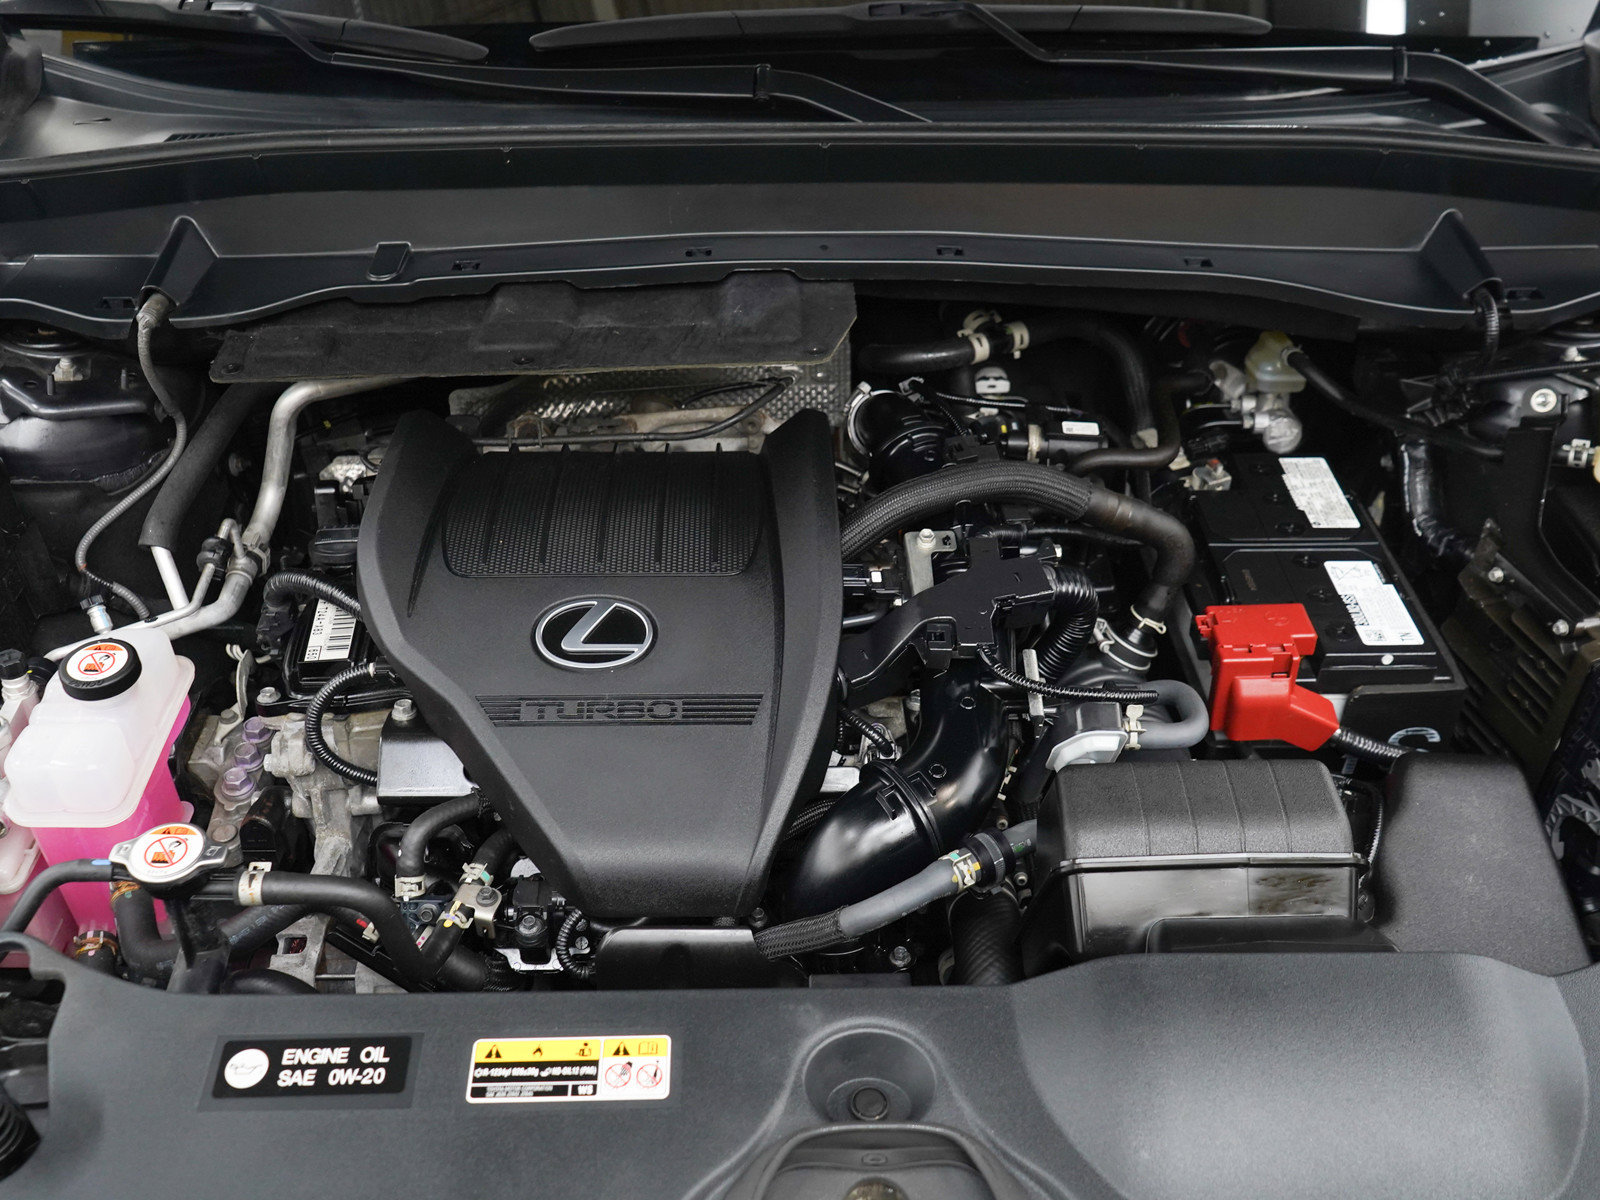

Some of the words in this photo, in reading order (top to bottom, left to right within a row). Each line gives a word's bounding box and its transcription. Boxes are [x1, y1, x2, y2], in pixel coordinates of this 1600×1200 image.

[525, 699, 678, 720] TURBO
[281, 1047, 350, 1066] ENGINE
[359, 1045, 390, 1064] OIL
[277, 1069, 318, 1087] SAE
[328, 1067, 386, 1086] 0W-20
